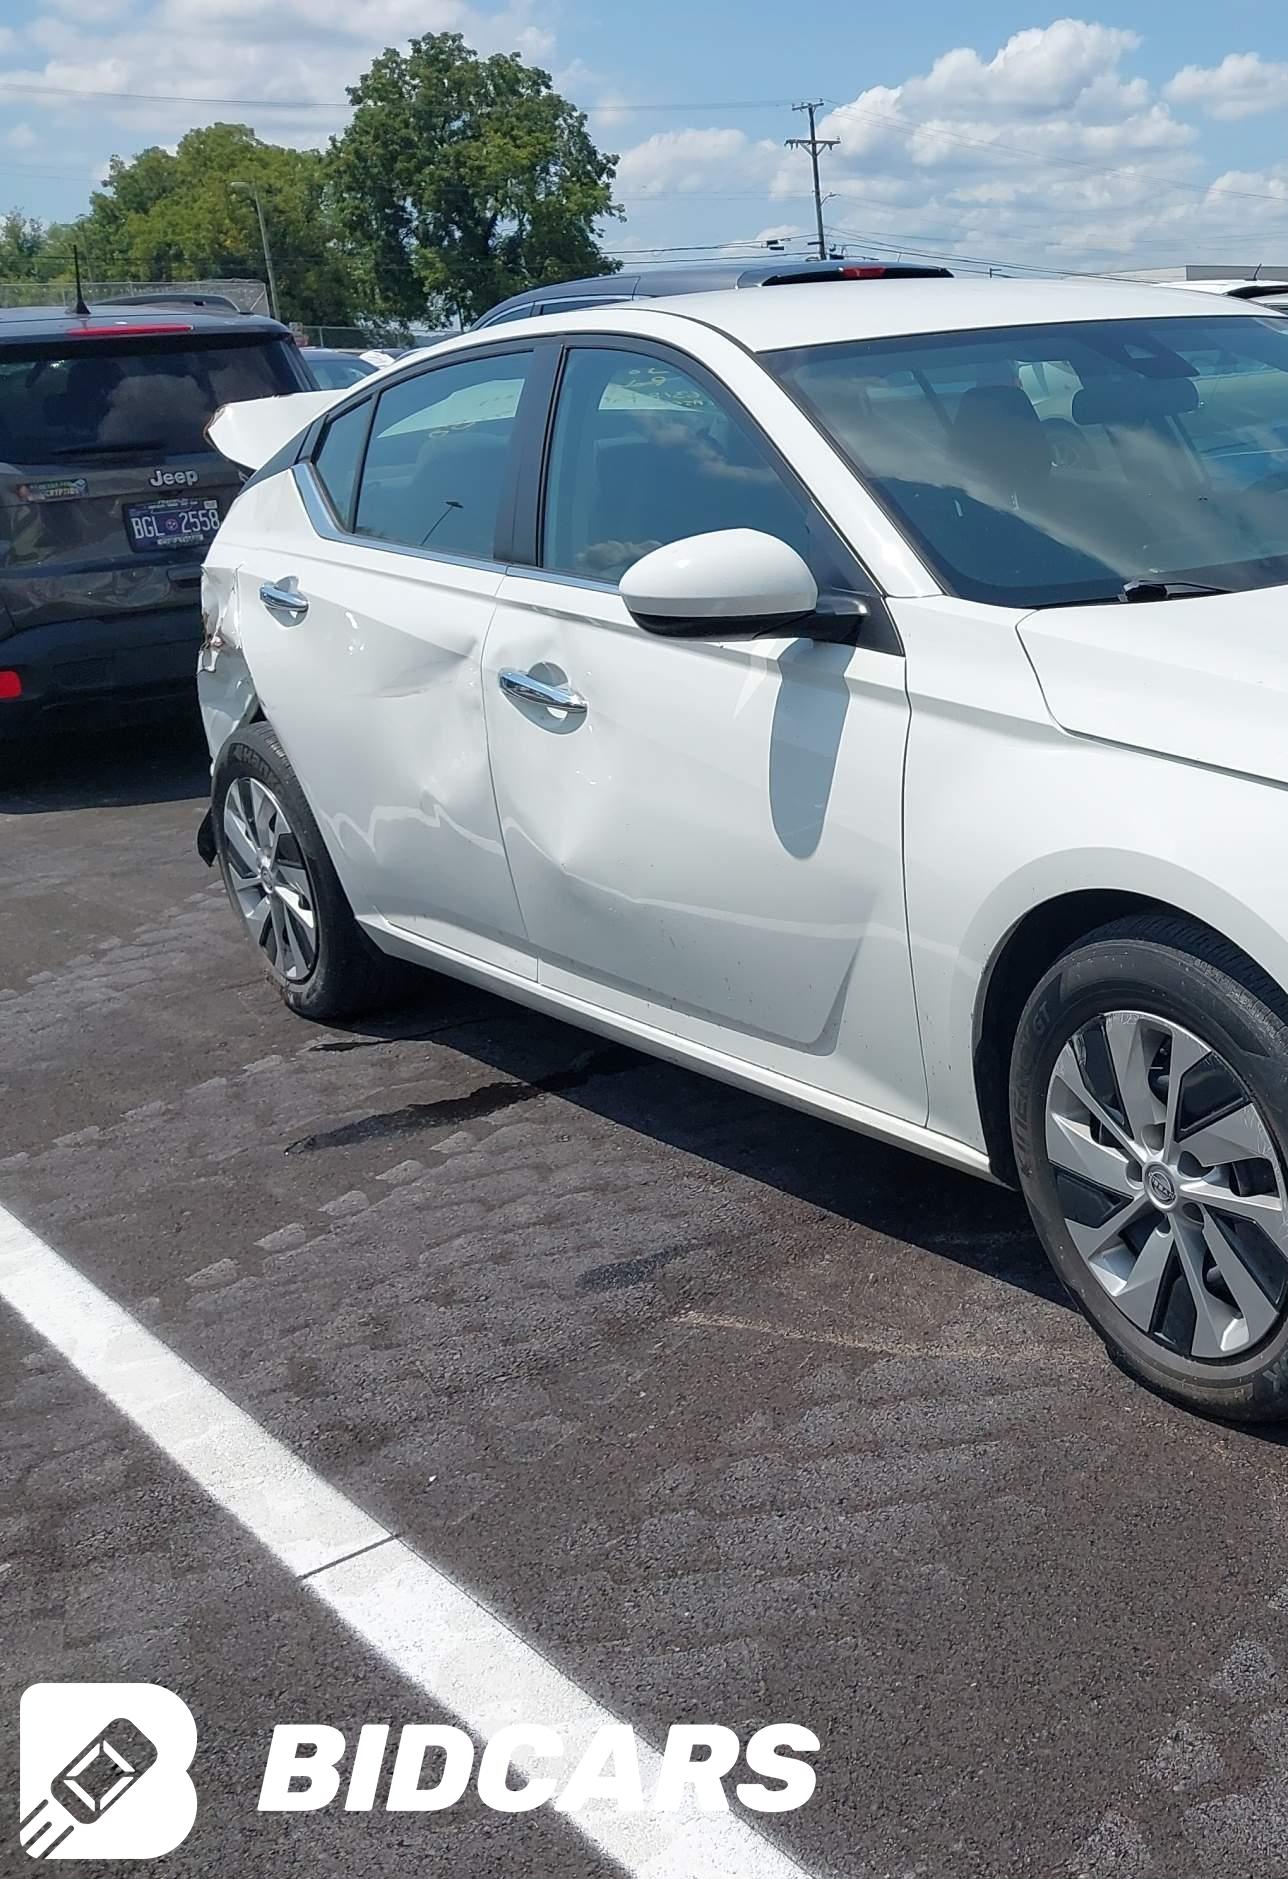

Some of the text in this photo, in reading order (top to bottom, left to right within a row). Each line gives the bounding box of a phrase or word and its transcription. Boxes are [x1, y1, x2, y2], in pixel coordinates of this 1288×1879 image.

[149, 470, 199, 487] Jeep
[130, 509, 220, 539] BGL 2558
